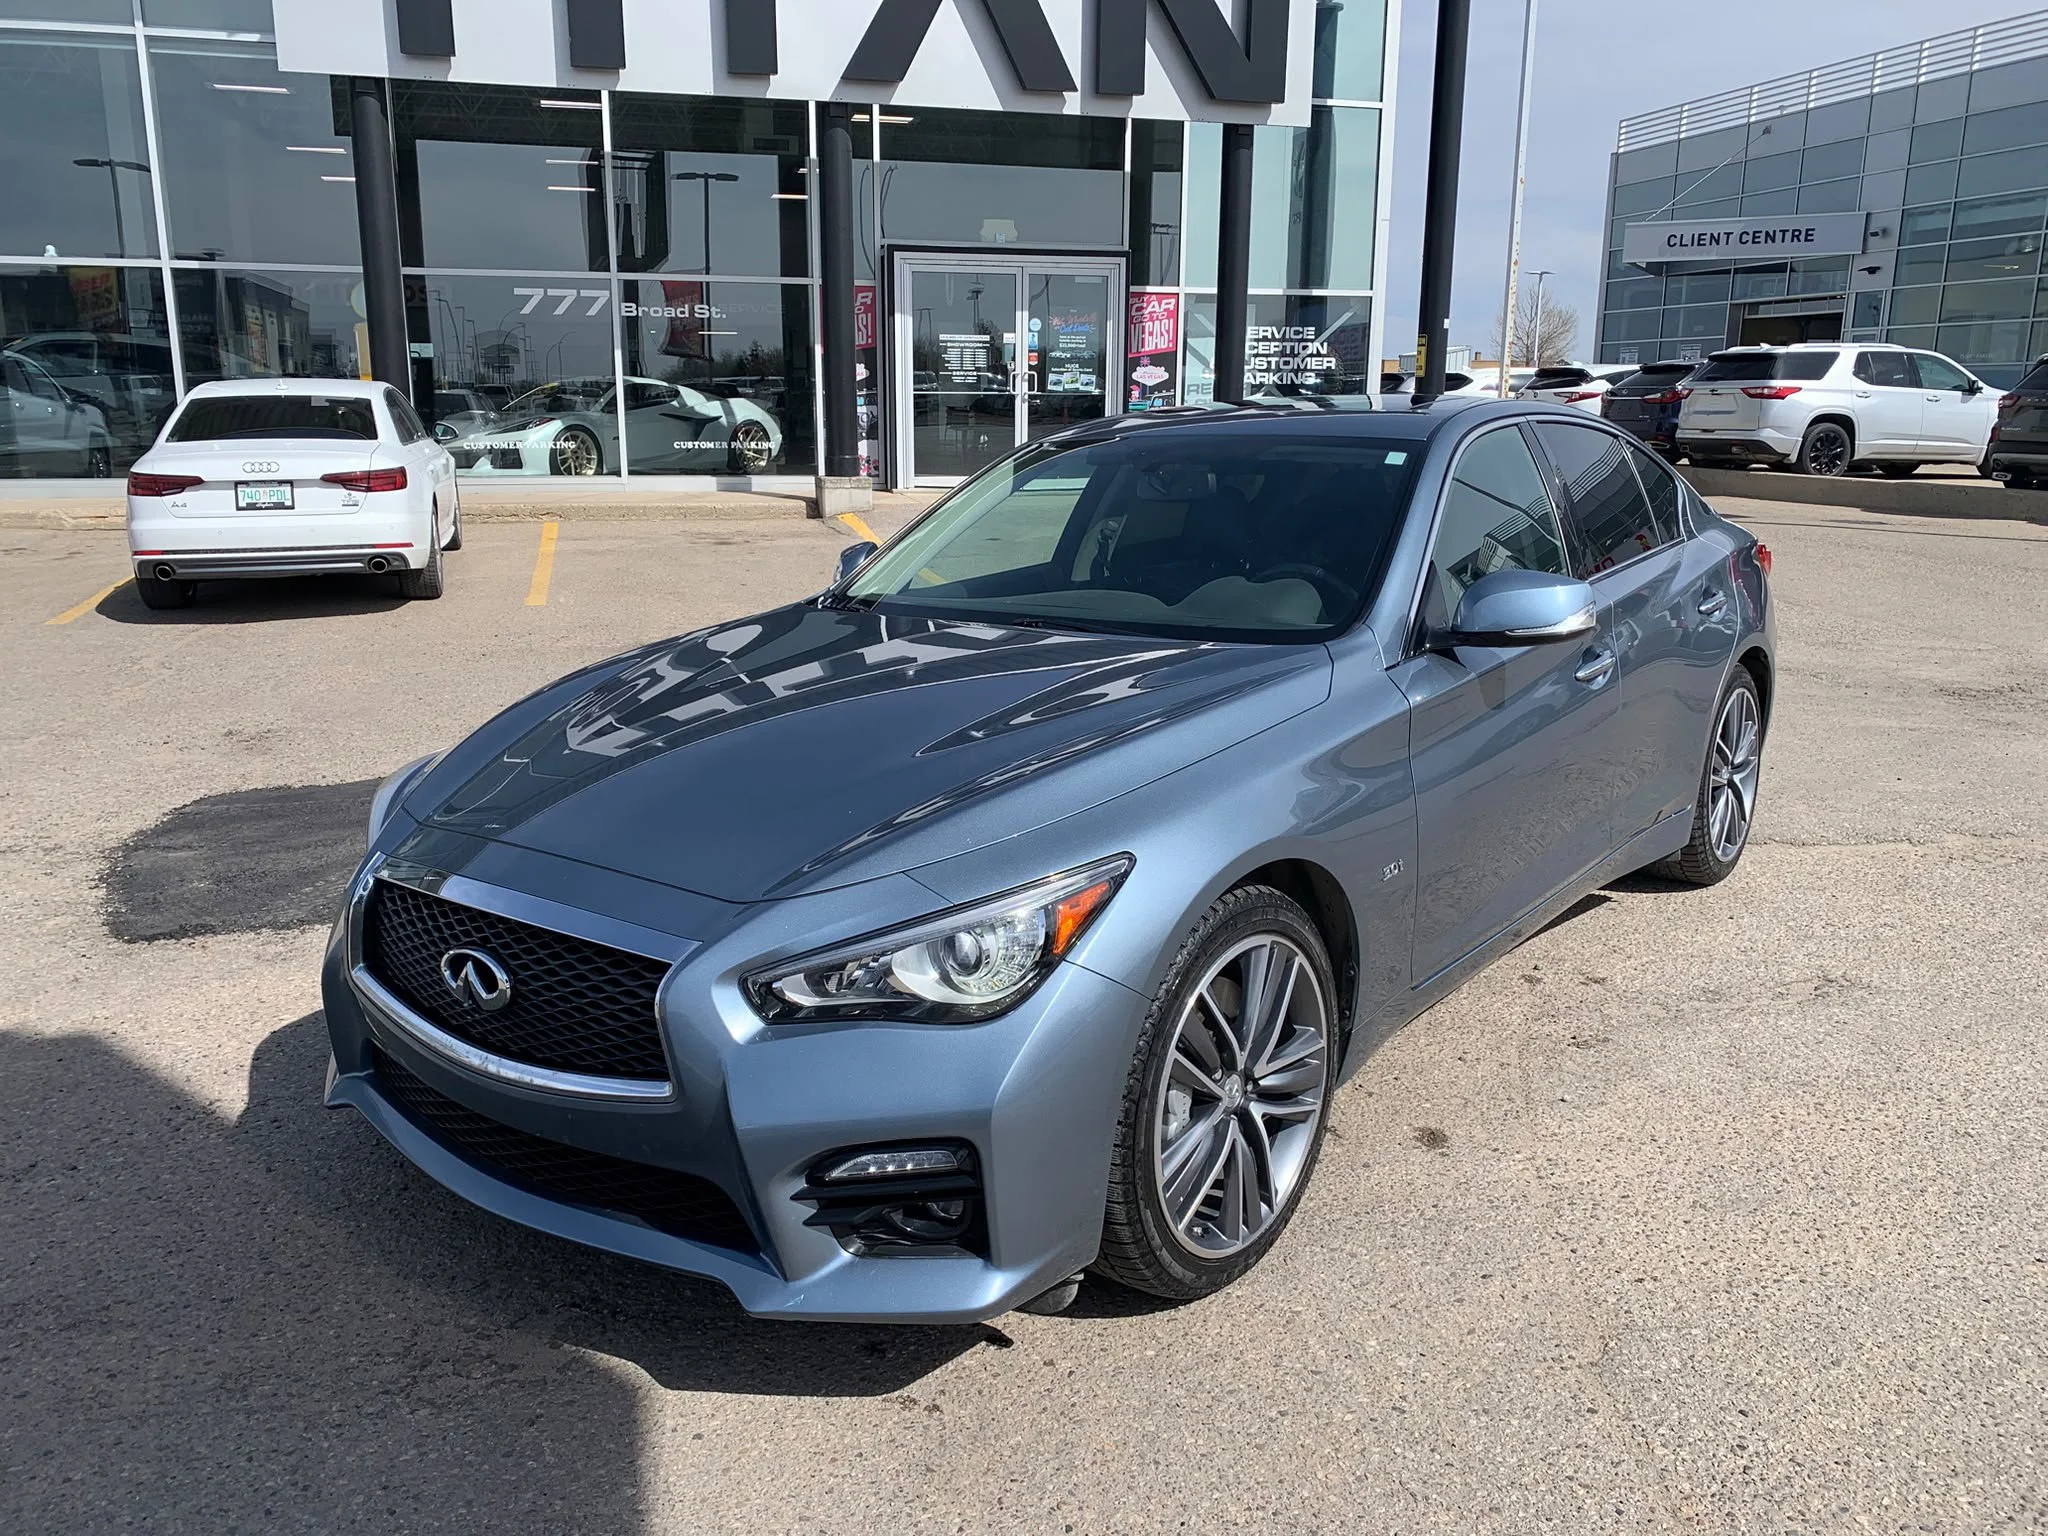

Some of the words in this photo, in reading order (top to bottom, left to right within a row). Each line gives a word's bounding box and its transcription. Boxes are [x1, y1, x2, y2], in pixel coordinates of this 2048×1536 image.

[1666, 231, 1734, 248] CLIENT
[1738, 227, 1816, 244] CENTRE
[513, 287, 610, 318] 777
[620, 303, 690, 318] Broad
[694, 304, 727, 319] St.
[1131, 298, 1176, 316] CAR
[1133, 313, 1150, 323] GO
[1152, 312, 1168, 320] TO
[1130, 318, 1174, 353] VEGAS!
[1246, 326, 1316, 339] ERVICE
[1244, 342, 1328, 355] CEPTION
[1243, 357, 1336, 370] USTOMER
[1243, 371, 1317, 385] ARKING
[463, 441, 524, 450] CUSTOMER
[673, 441, 728, 449] CUSTOMER
[730, 441, 776, 449] PARKING
[239, 489, 262, 501] 740
[268, 489, 290, 501] PDL
